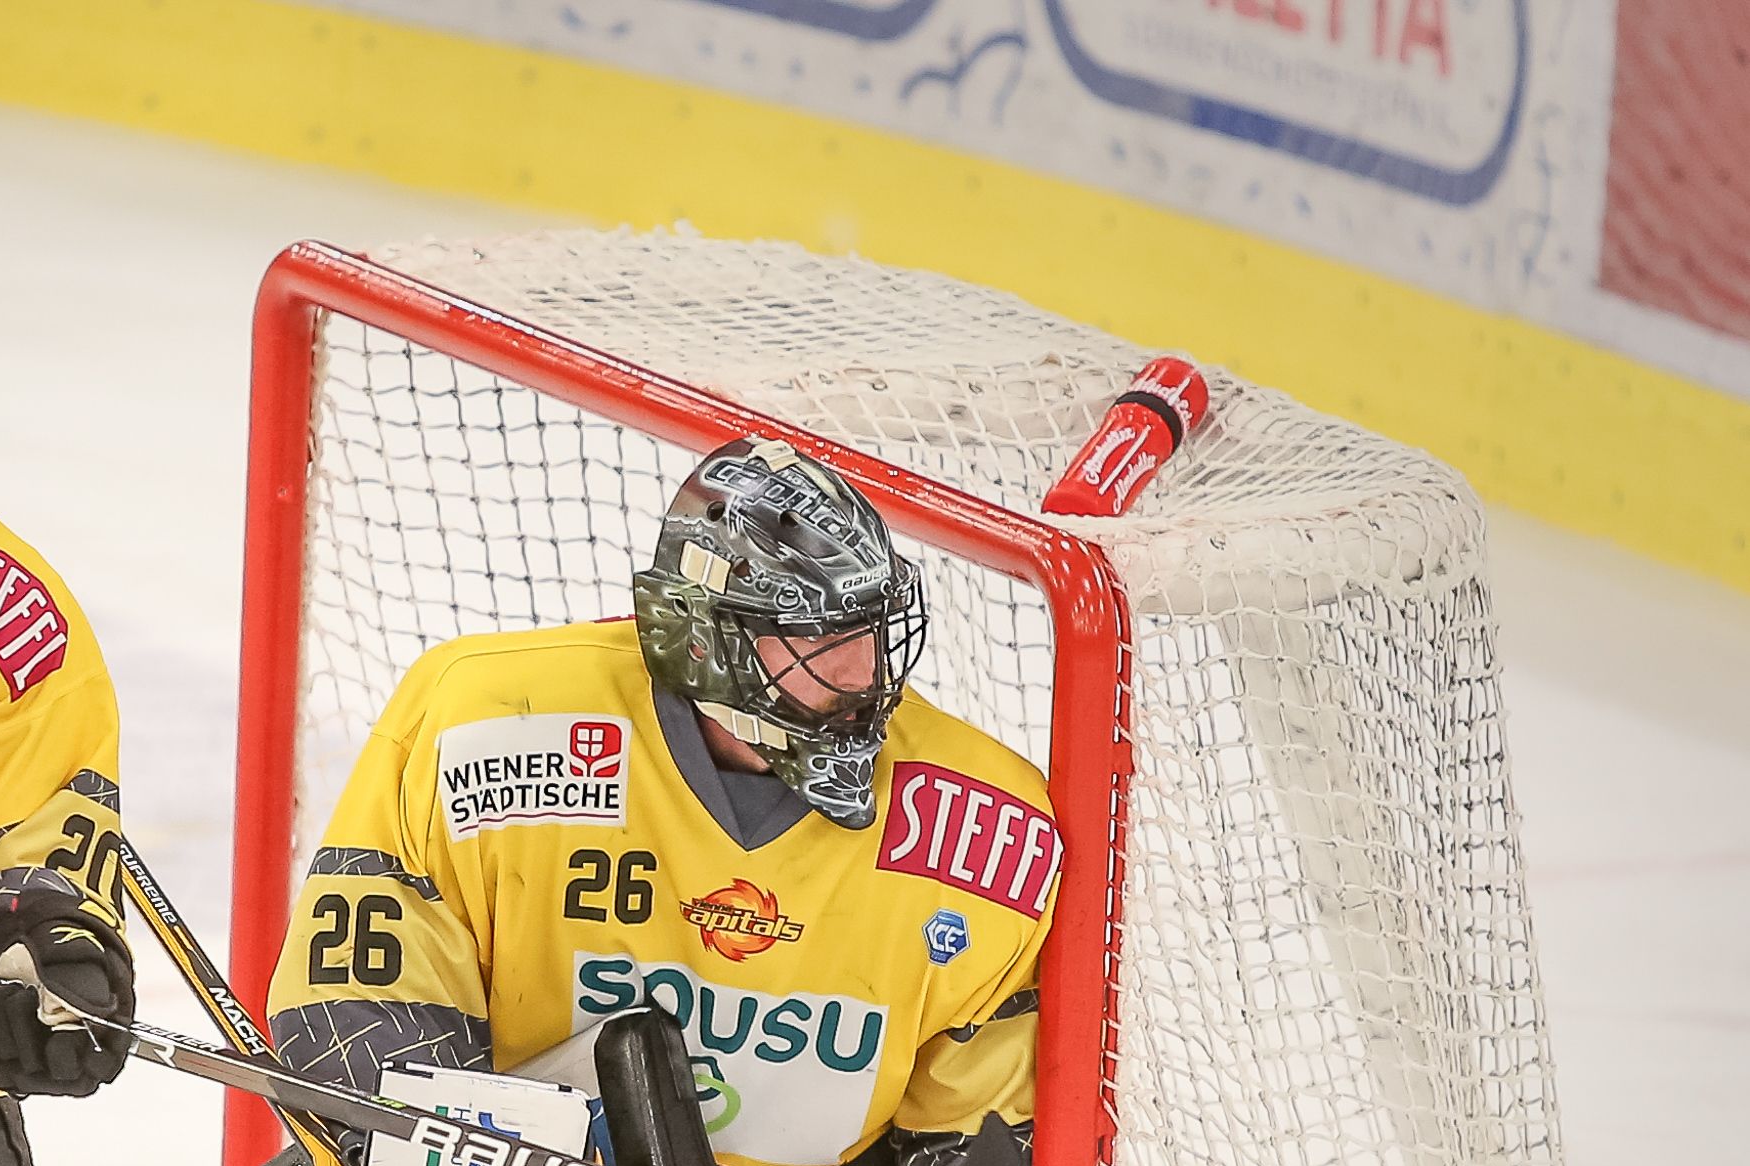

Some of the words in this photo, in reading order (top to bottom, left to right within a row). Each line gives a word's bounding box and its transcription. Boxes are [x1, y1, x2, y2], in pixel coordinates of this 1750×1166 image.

[443, 751, 566, 794] WIENER
[450, 781, 621, 824] STÄDTISCHE
[45, 813, 126, 921] 20
[563, 848, 658, 925] 26
[307, 892, 404, 988] 26
[207, 985, 267, 1056] MACH
